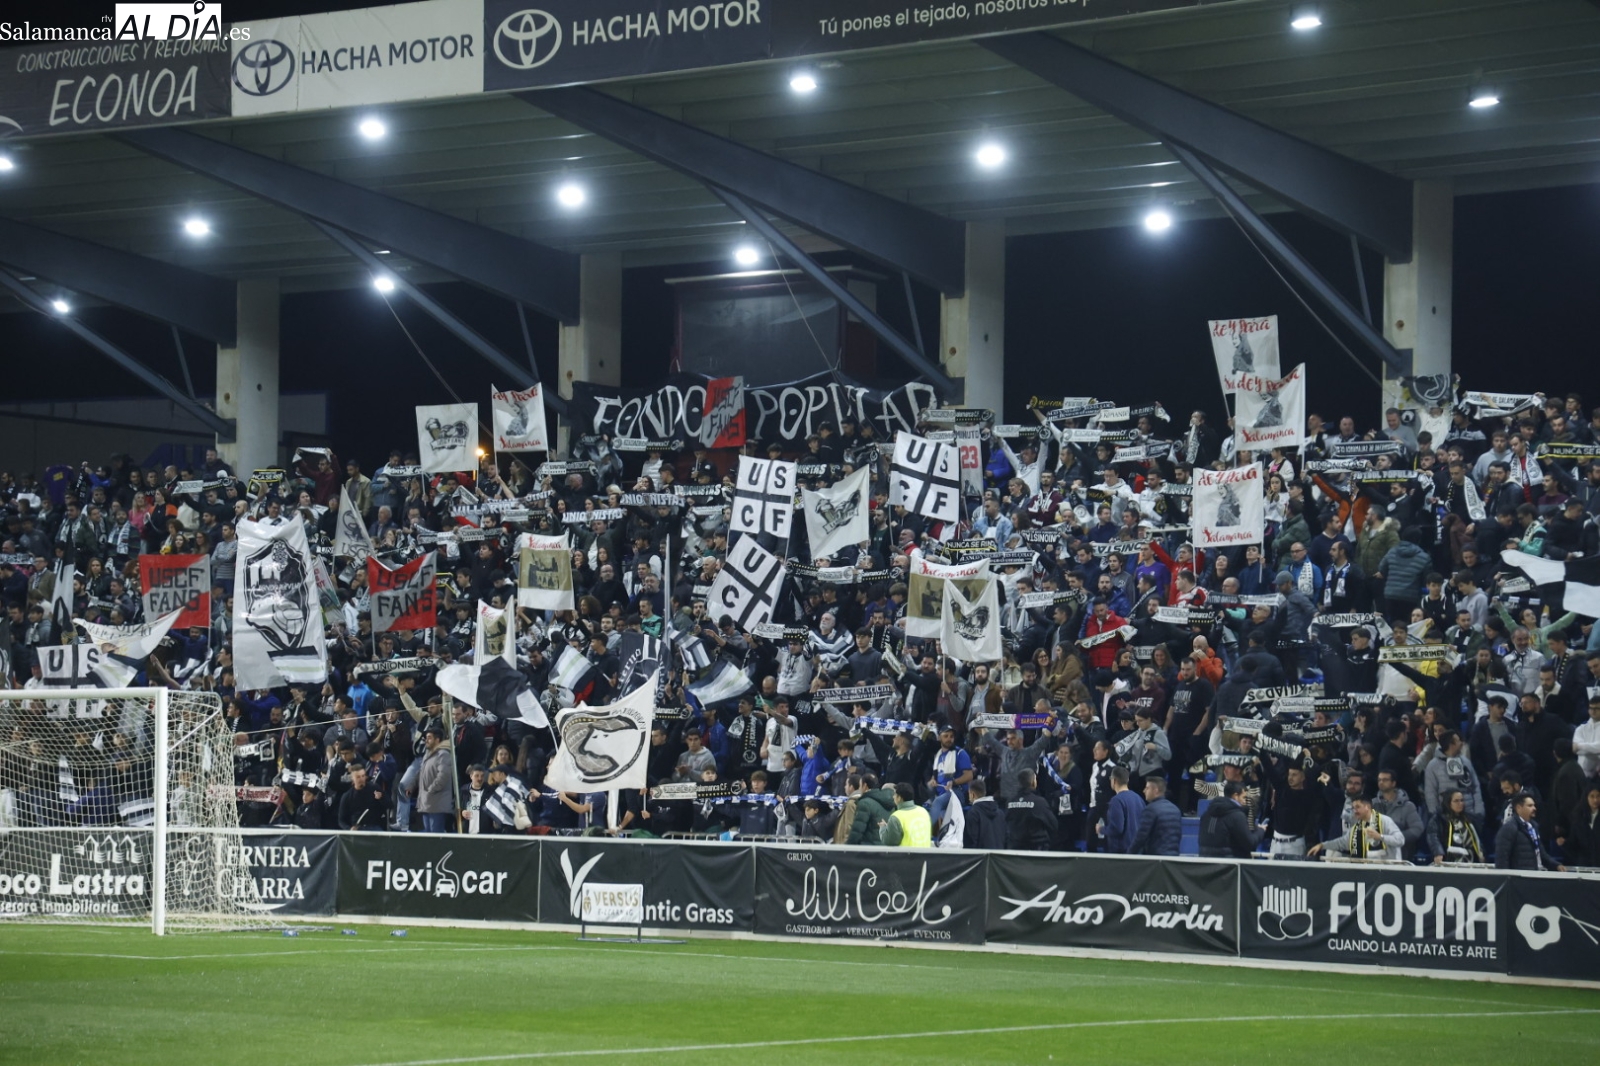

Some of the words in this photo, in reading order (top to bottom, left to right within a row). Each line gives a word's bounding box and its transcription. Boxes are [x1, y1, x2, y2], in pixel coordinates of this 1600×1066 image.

[573, 11, 661, 46] HACHA
[667, 0, 761, 35] MOTOR
[819, 17, 838, 35] Tú
[842, 15, 891, 37] pones
[896, 11, 910, 26] el
[913, 5, 971, 28] tejado,
[16, 42, 138, 73] CONSTRUCCIONES
[300, 42, 383, 75] HACHA
[388, 33, 474, 66] MOTOR
[50, 65, 199, 127] ECONOA
[593, 384, 707, 439] FONDO
[960, 445, 980, 470] 23
[946, 541, 970, 549] NUNCA
[147, 567, 205, 590] USCF
[150, 589, 201, 613] FANS
[377, 588, 433, 618] FANS
[371, 657, 435, 672] UNIONISTAS
[787, 852, 812, 862] GRUPO
[49, 853, 145, 896] Lastra
[217, 868, 305, 900] CHARRA
[41, 899, 119, 914] Inmobiliaria
[593, 890, 639, 907] VERSUS
[1131, 892, 1190, 905] AUTOCARES
[642, 899, 682, 923] ntic
[685, 902, 734, 925] Grass
[1328, 881, 1497, 943] FLOYMA
[785, 924, 832, 936] GASTROBAR
[913, 929, 951, 941] EVENTOS
[1327, 938, 1380, 953] CUANDO
[1381, 939, 1398, 955] LA
[1400, 941, 1448, 957] PATATA
[1450, 944, 1464, 958] ES
[1466, 945, 1497, 960] ARTE
